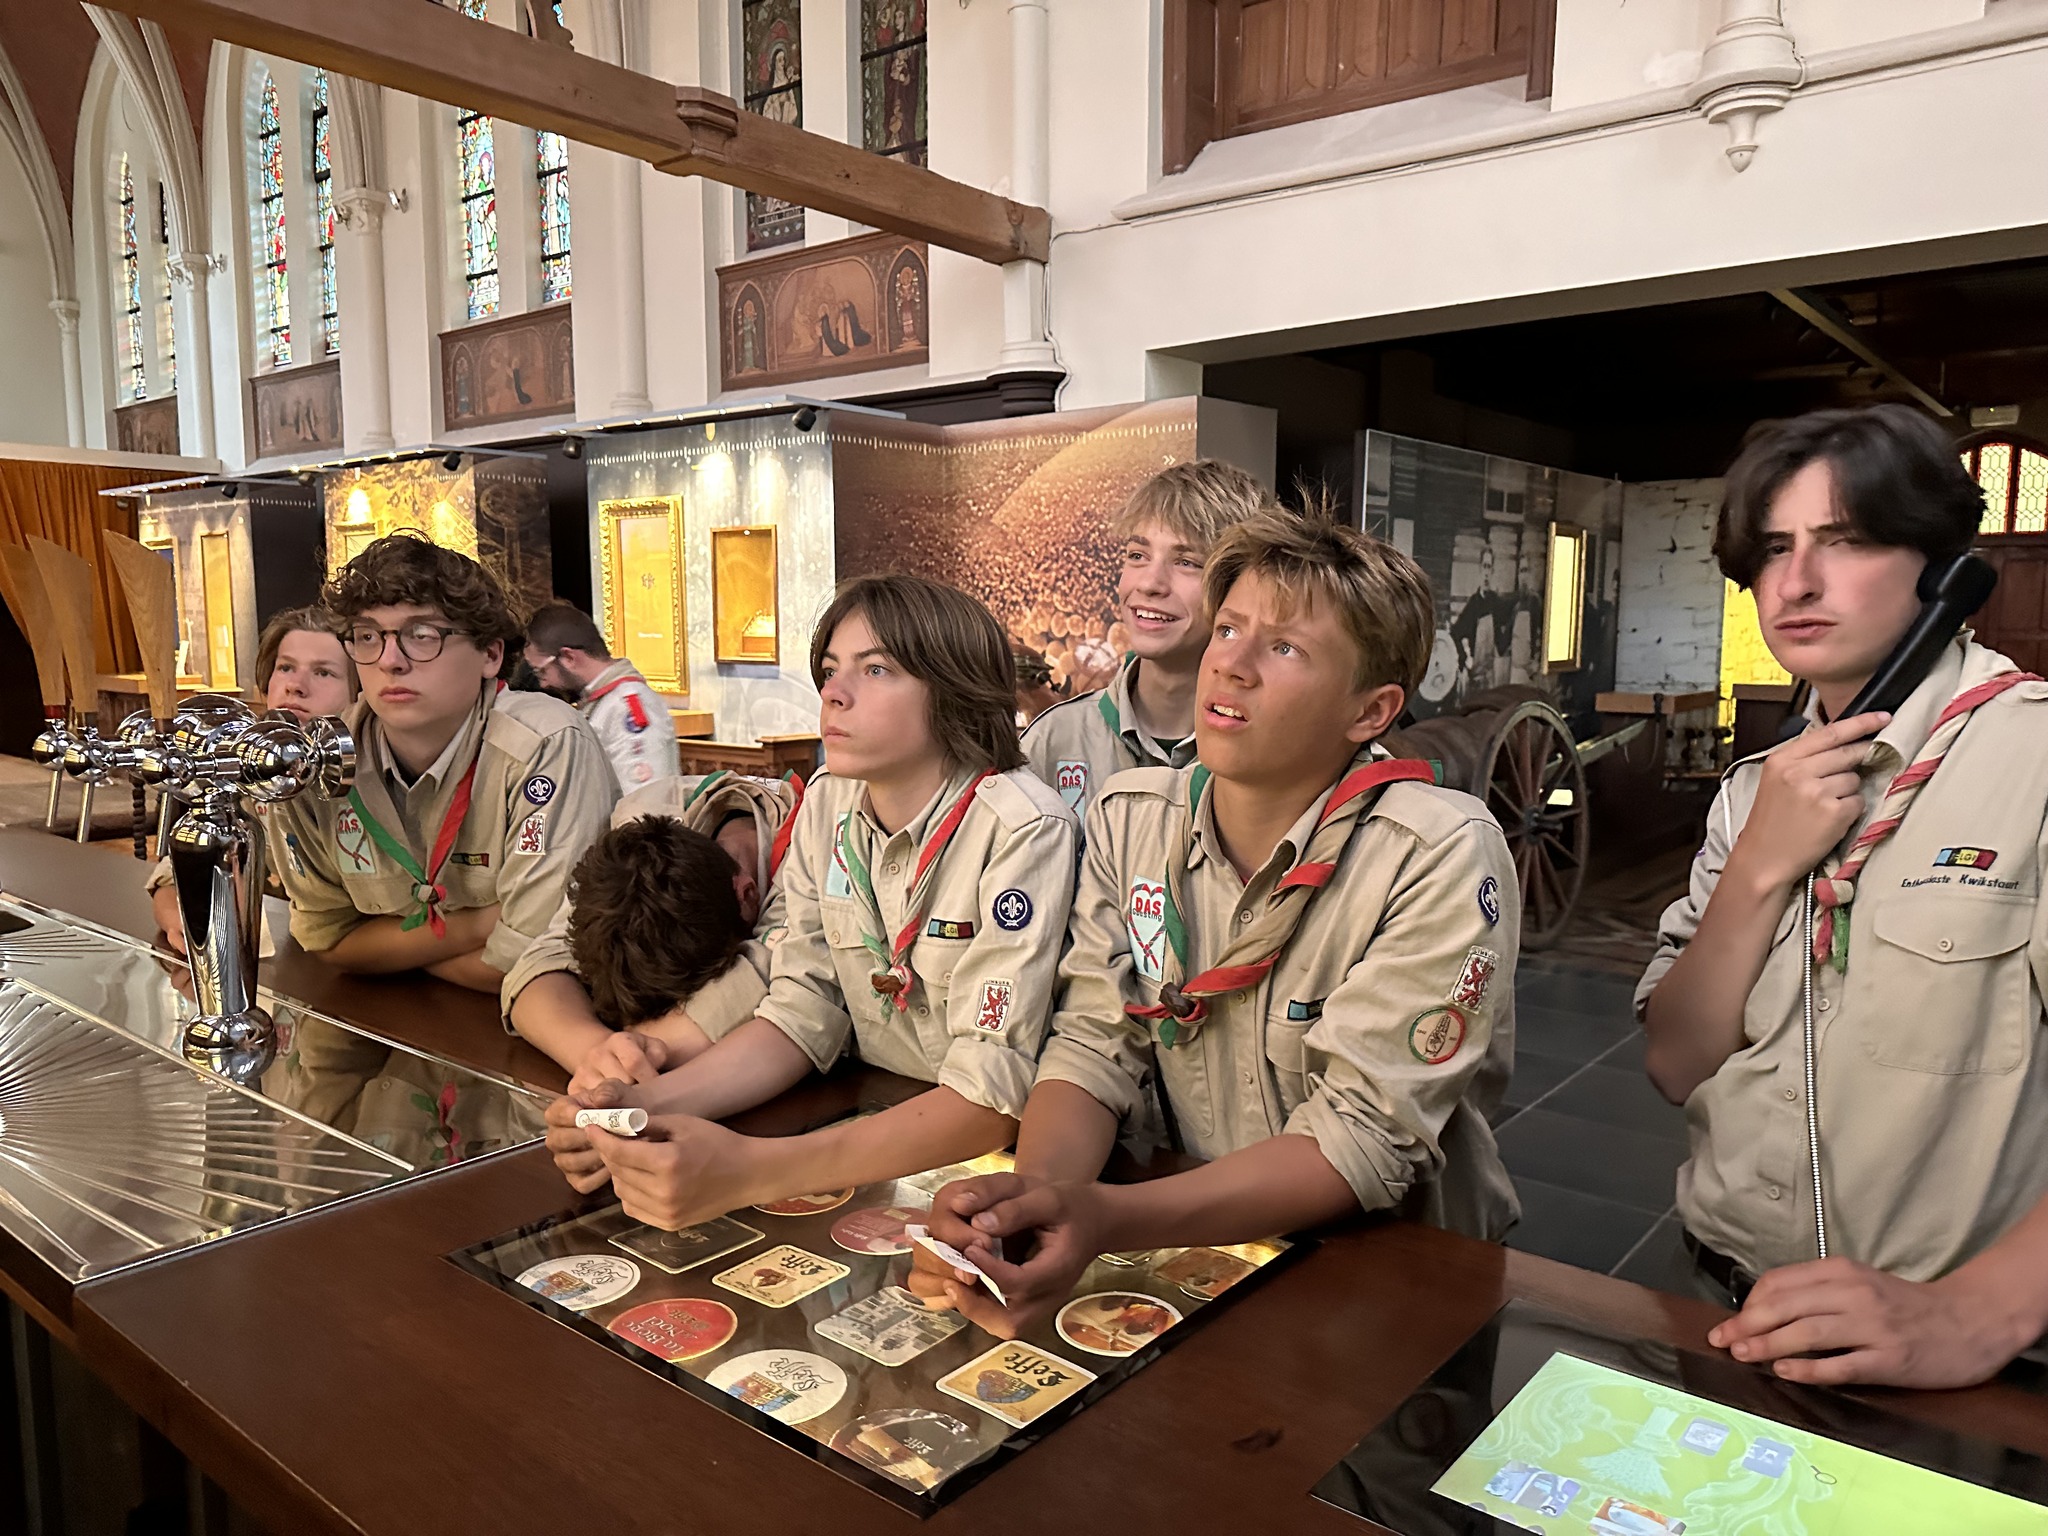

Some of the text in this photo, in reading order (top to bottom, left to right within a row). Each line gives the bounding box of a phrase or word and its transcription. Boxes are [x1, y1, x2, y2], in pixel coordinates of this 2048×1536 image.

[1061, 774, 1081, 788] DAS
[1135, 896, 1162, 916] DAS
[780, 1254, 827, 1276] Leffe
[765, 1357, 834, 1392] Leffe
[1004, 1352, 1073, 1387] Leffe
[903, 1436, 934, 1455] Leffe
